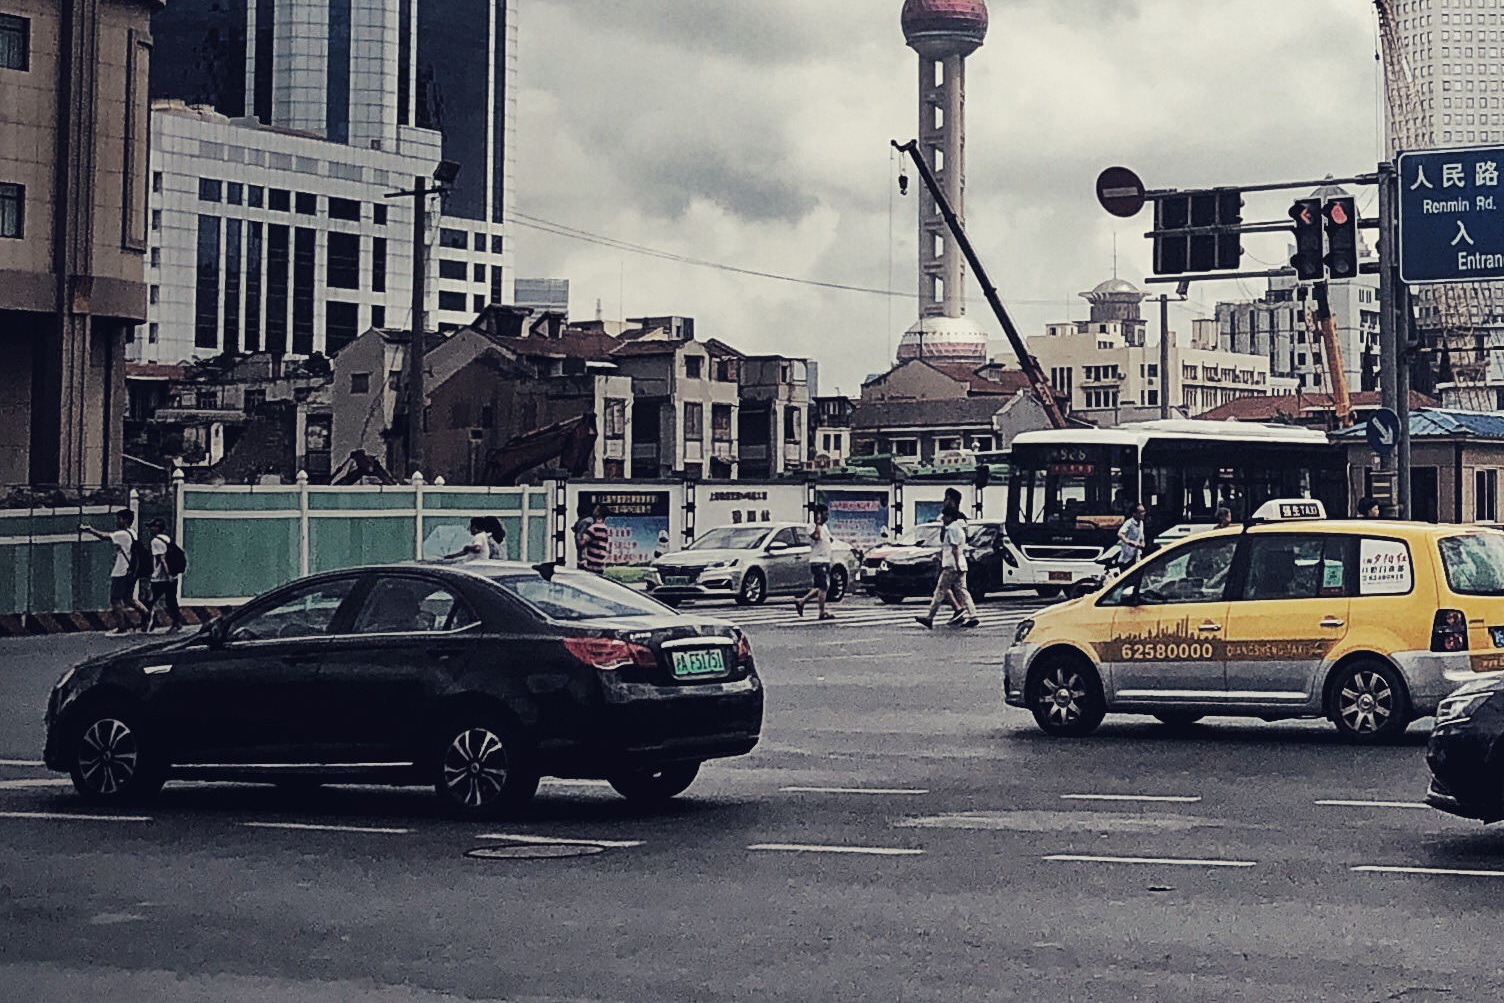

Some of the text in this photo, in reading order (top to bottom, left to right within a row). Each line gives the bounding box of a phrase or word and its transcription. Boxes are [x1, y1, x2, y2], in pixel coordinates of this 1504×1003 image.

[1423, 197, 1470, 214] Renmin
[1476, 196, 1497, 211] Rd.
[1121, 644, 1213, 659] 62580000
